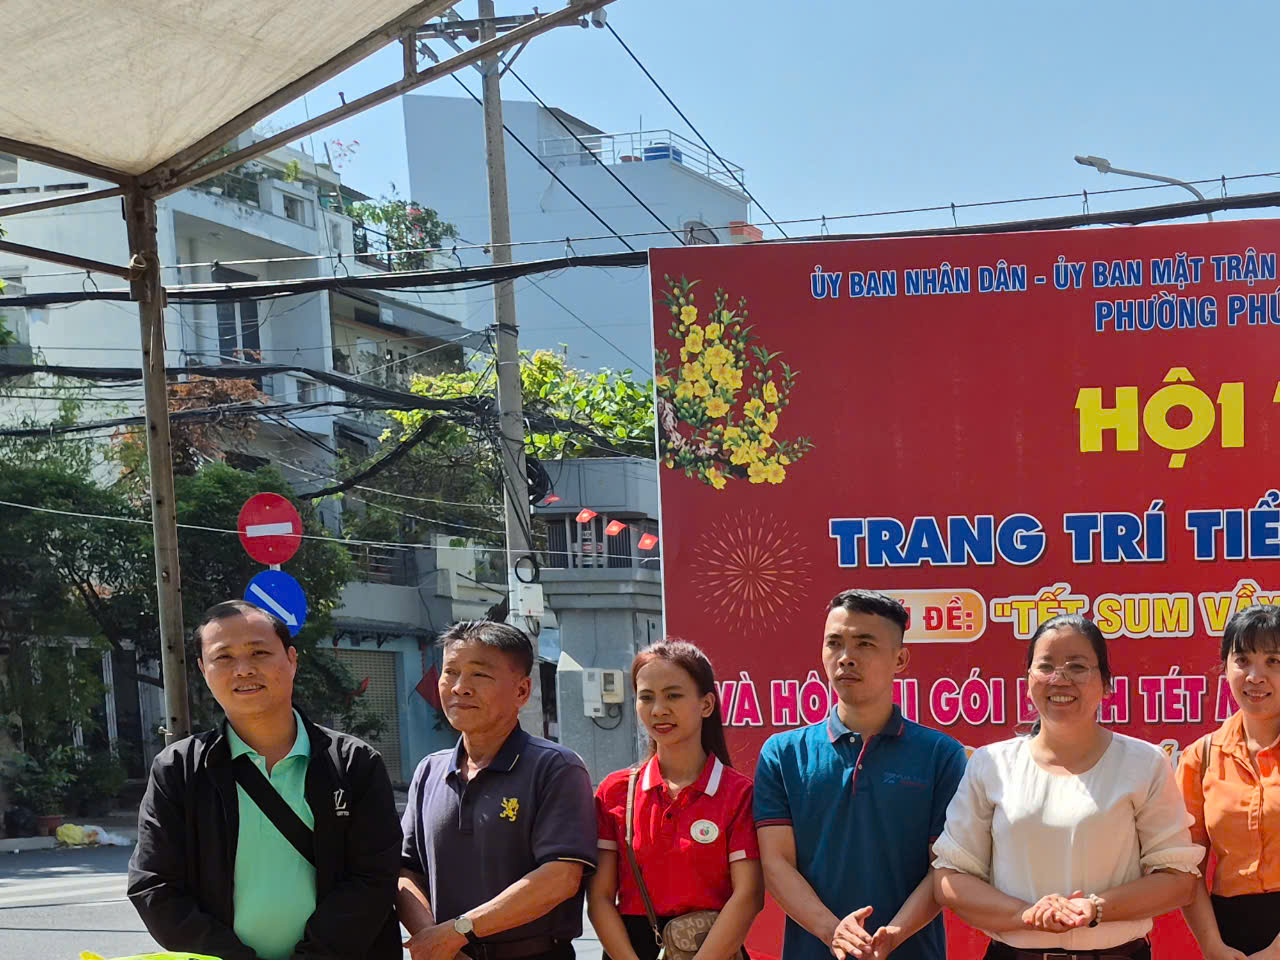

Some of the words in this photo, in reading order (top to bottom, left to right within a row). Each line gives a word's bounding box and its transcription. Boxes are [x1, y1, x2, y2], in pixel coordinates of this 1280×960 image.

[811, 264, 842, 299] ỦY
[849, 270, 897, 297] BAN
[904, 261, 970, 296] NHÂN
[978, 259, 1027, 293] DÂN
[1053, 255, 1086, 290] ỦY
[1092, 259, 1143, 288] BAN
[1150, 252, 1204, 290] MẶT
[1210, 247, 1276, 286] TRẬN
[1095, 291, 1217, 332] PHƯỜNG
[1075, 366, 1245, 469] HỘI
[829, 513, 1046, 567] TRANG
[1063, 499, 1166, 563] TRÍ
[922, 595, 973, 631] ĐỀ:
[1096, 594, 1190, 635] SUM
[930, 667, 1006, 726] GÓI
[1139, 666, 1206, 723] TÉT
